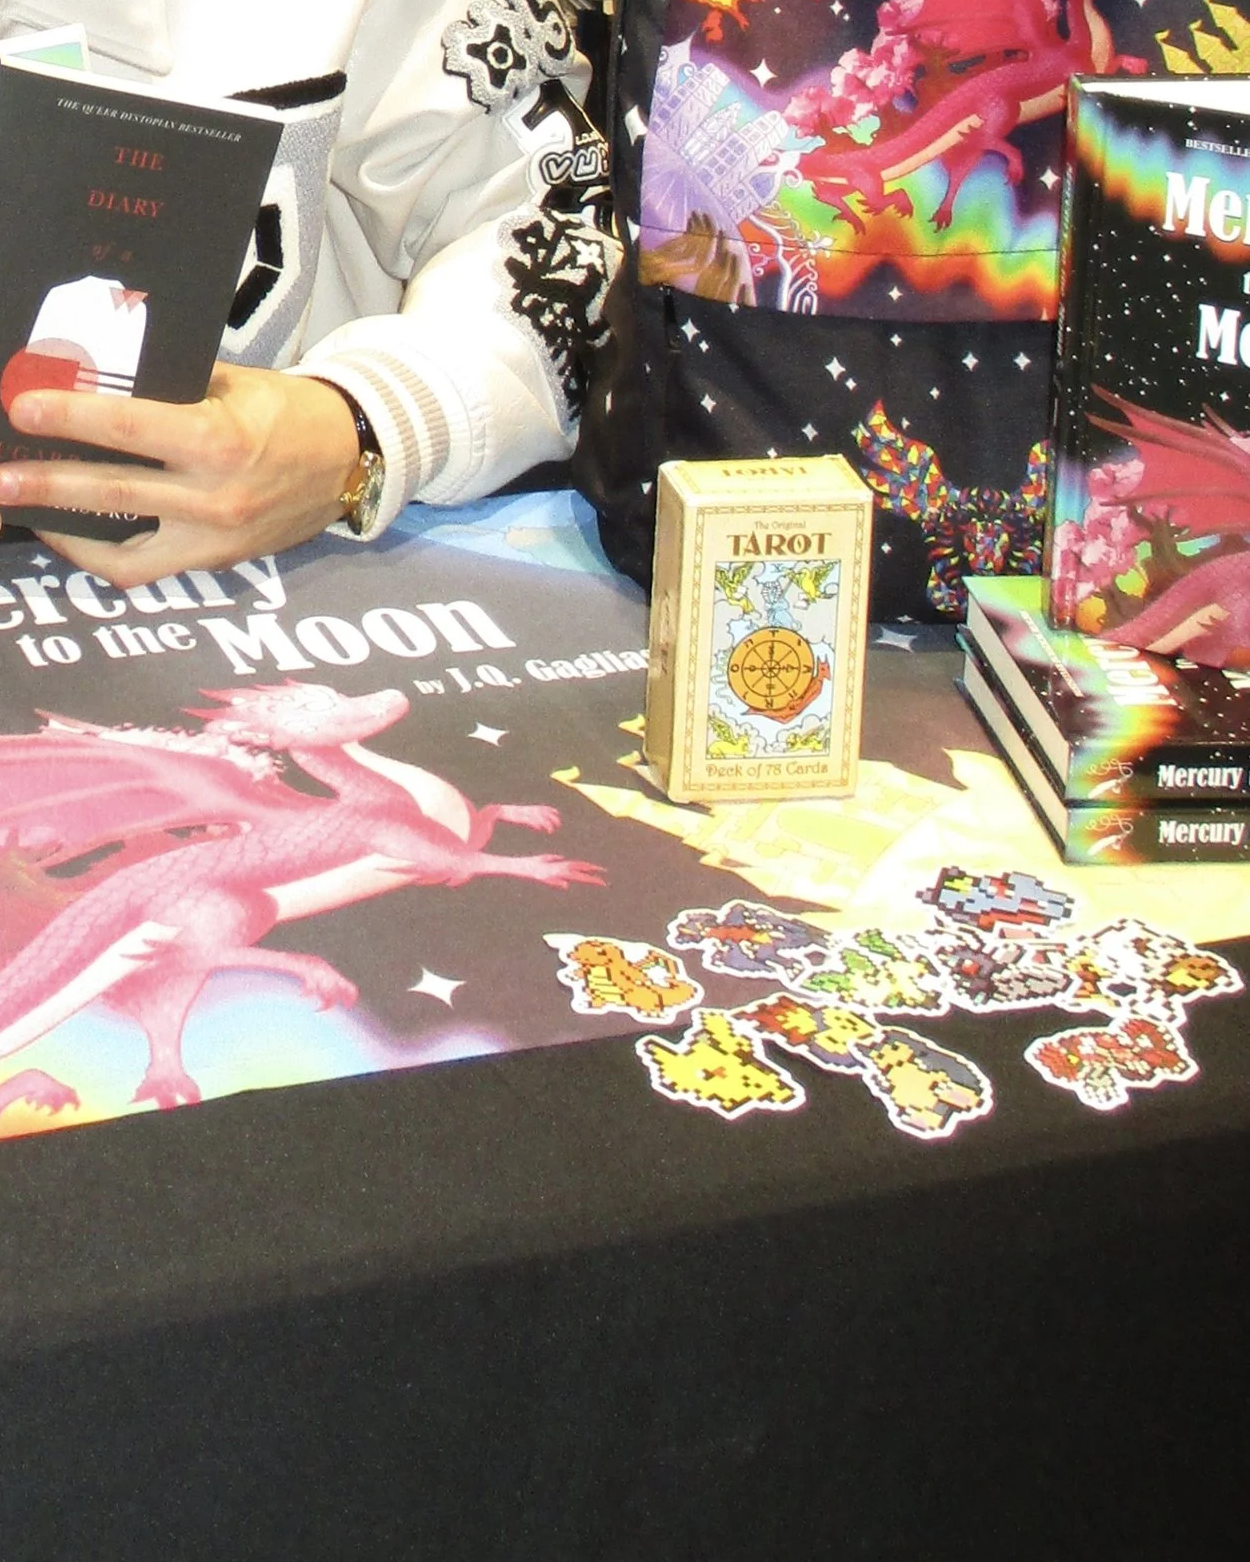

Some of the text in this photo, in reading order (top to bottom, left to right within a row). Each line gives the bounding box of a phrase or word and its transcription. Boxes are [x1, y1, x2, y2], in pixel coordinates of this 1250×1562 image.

[57, 97, 242, 143] THE QUEER DYSTOPIAN BESTSELLER
[114, 146, 164, 172] THE
[1185, 138, 1250, 158] BESTSELLE
[88, 189, 167, 219] DIARY
[91, 244, 134, 262] of a
[754, 519, 807, 531] The Original
[726, 531, 832, 557] TAROT
[16, 598, 517, 676] to the Moon
[414, 648, 650, 696] by J.Q. Gaglias
[705, 760, 829, 780] Deck of 78 Cards
[1158, 764, 1244, 789] Mercury
[1159, 820, 1246, 845] Mercury
